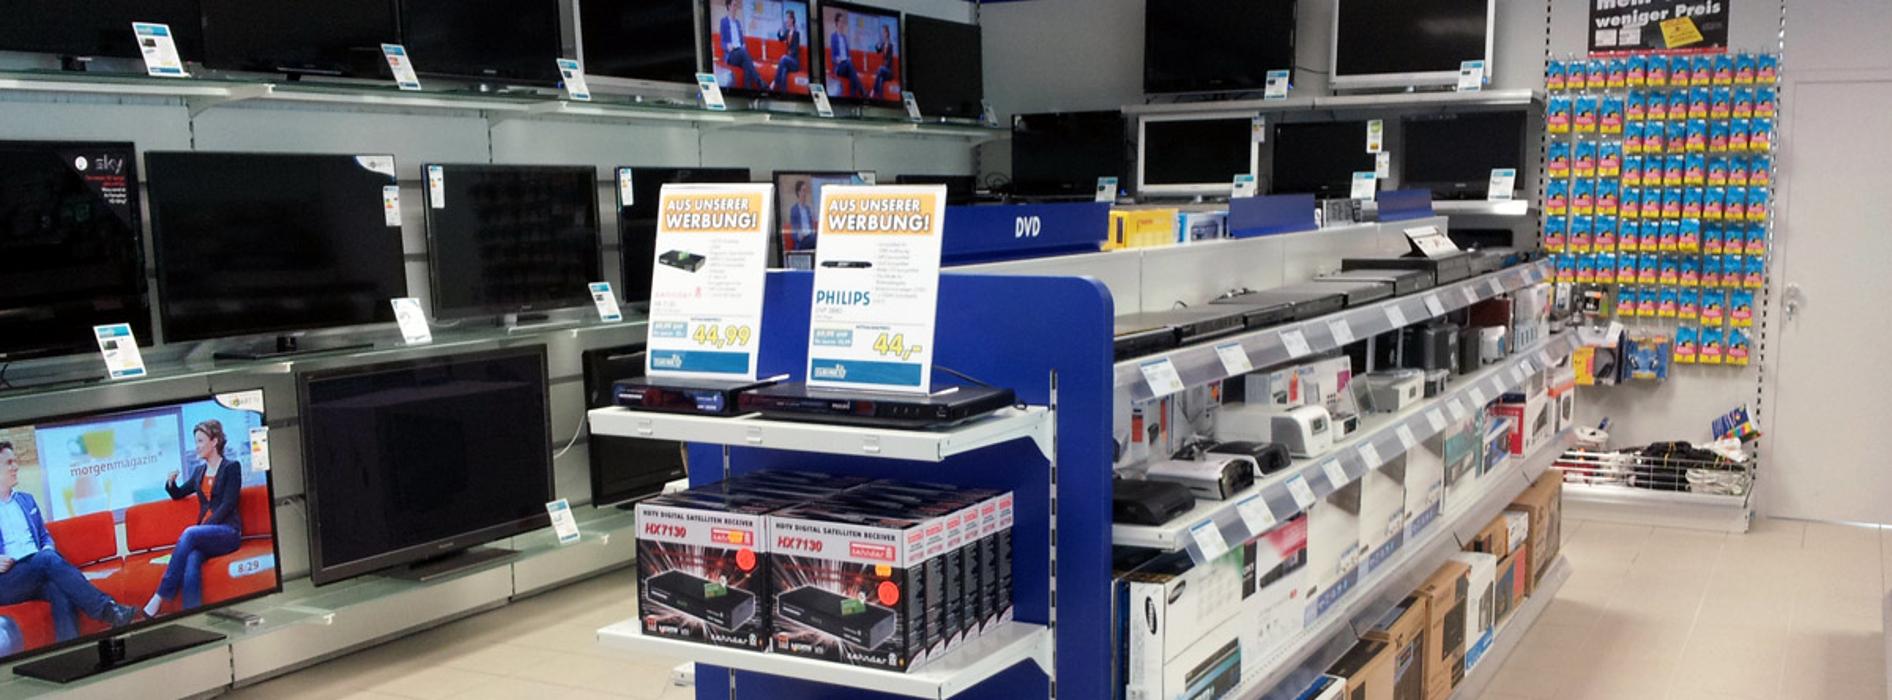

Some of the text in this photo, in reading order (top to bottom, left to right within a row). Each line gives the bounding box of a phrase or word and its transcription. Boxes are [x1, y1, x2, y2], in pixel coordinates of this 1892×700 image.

[1595, 1, 1721, 27] weniger Preis
[96, 154, 123, 174] sky
[667, 199, 749, 211] AUS UNSERER
[829, 199, 920, 212] AUS UNSERER
[666, 212, 757, 229] WERBUNG!
[829, 214, 930, 231] WERBUNG!
[1015, 216, 1041, 238] DVD
[816, 290, 870, 306] PHILIPS
[692, 324, 751, 349] 44,99
[873, 332, 922, 361] 44,-
[661, 511, 685, 520] DIGITAL
[686, 513, 722, 524] SATELLITEN
[724, 518, 753, 527] RECEIVER
[795, 523, 821, 534] DIGITAL
[823, 527, 862, 537] SATELLITEN
[864, 532, 896, 541] RECEIVER
